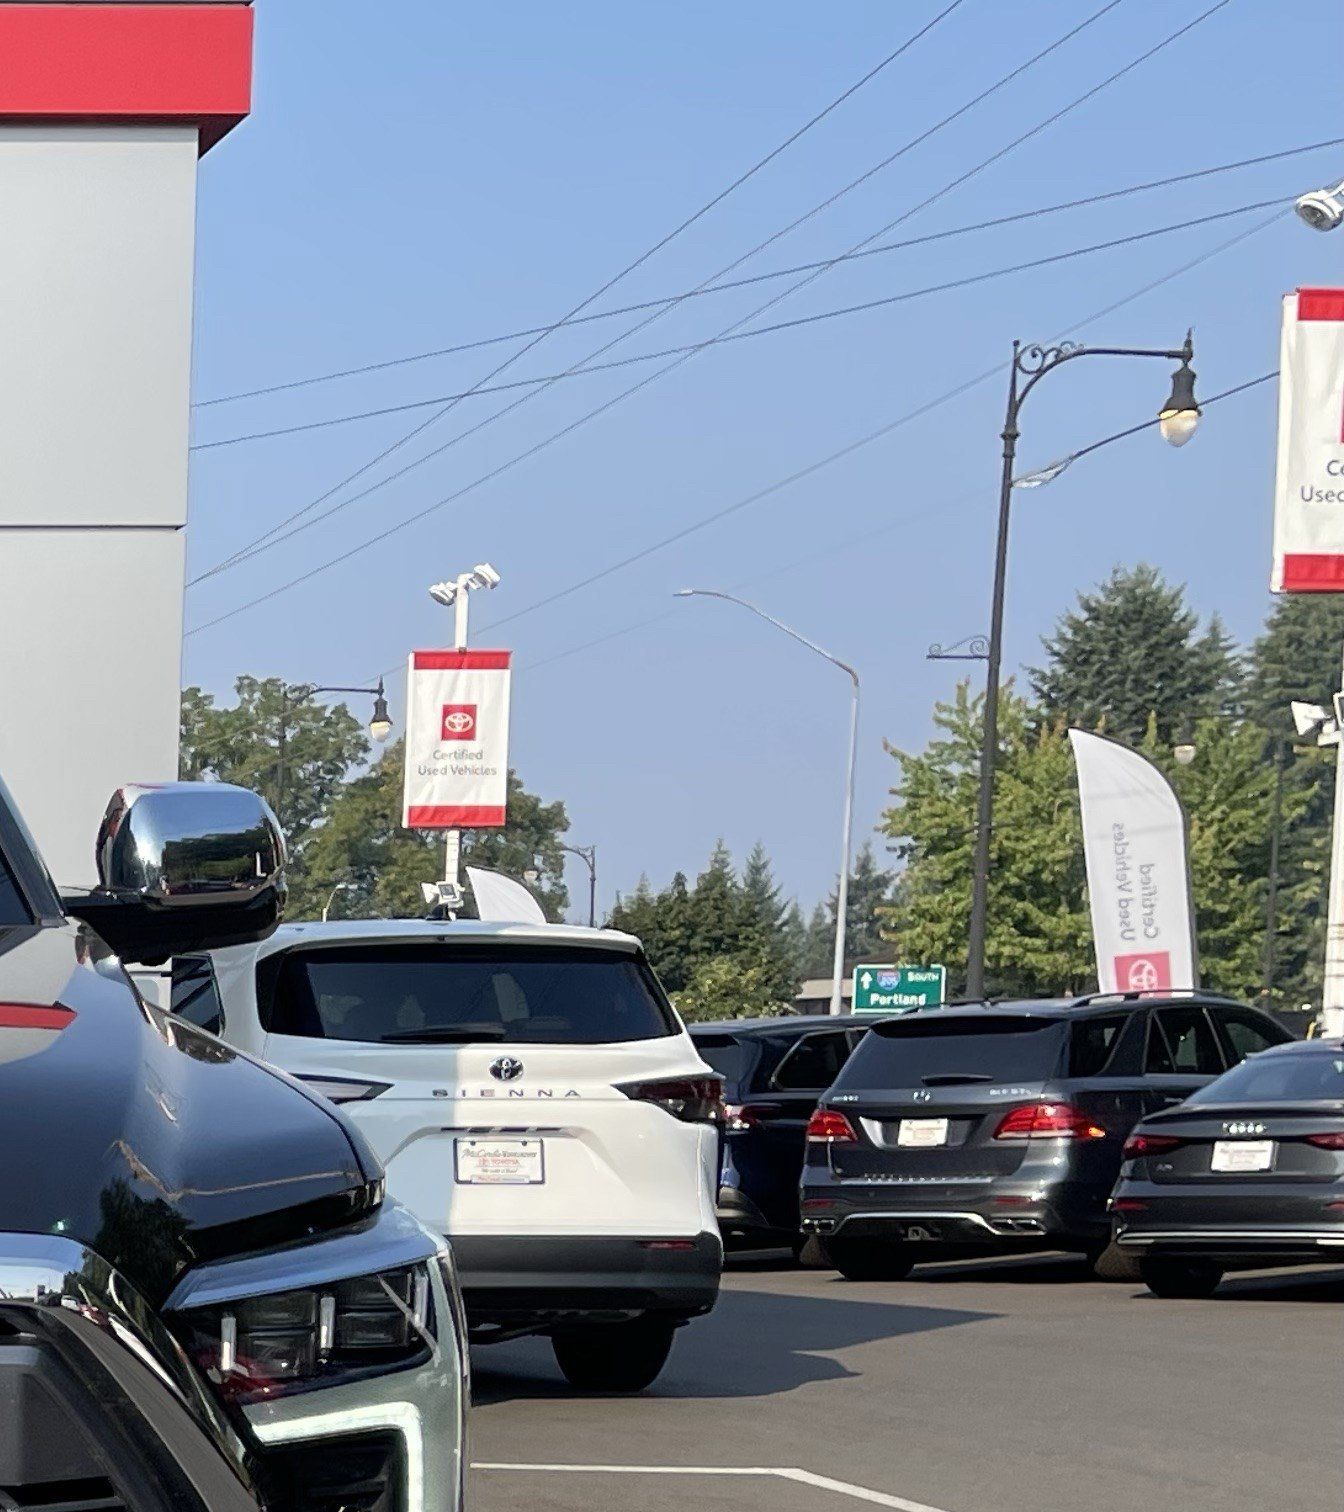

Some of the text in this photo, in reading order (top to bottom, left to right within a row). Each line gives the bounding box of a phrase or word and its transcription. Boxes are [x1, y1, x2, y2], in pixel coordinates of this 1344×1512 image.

[432, 748, 483, 760] Certified
[418, 764, 497, 776] Used Vehicles
[870, 993, 926, 1006] Portland
[432, 1089, 581, 1097] SIENNA
